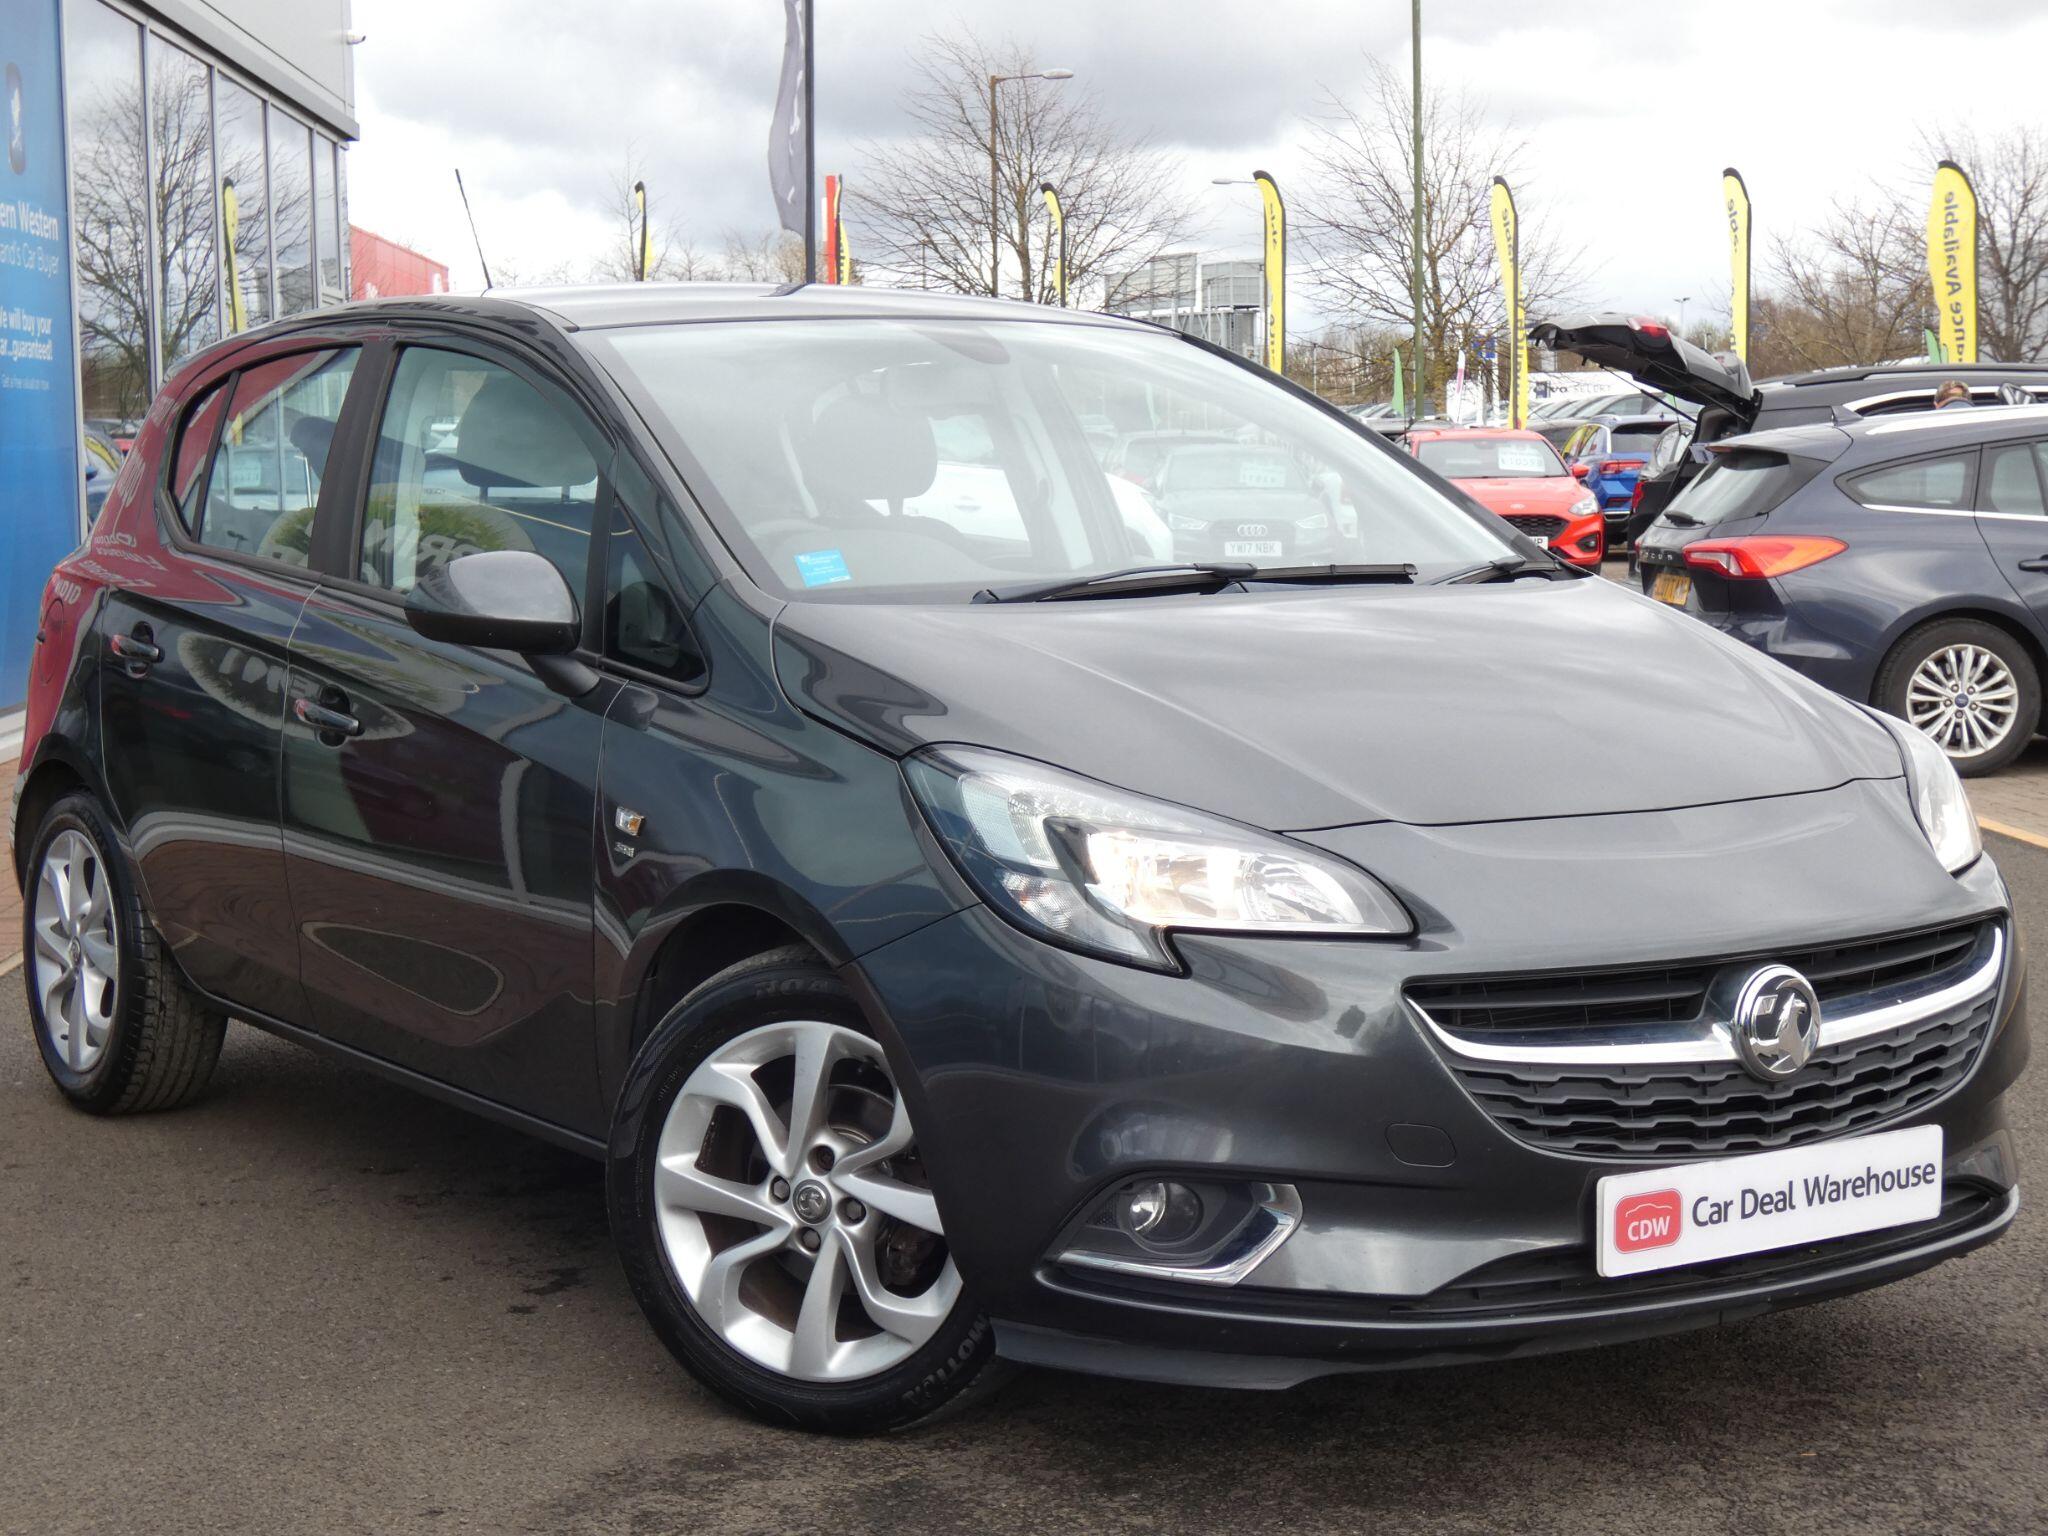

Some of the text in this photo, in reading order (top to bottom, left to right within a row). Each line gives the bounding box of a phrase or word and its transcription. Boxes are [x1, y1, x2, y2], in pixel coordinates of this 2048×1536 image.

[18, 199, 59, 241] Western
[1692, 1162, 1936, 1226] Car Deal Warehouse
[1626, 1215, 1671, 1242] CDW
